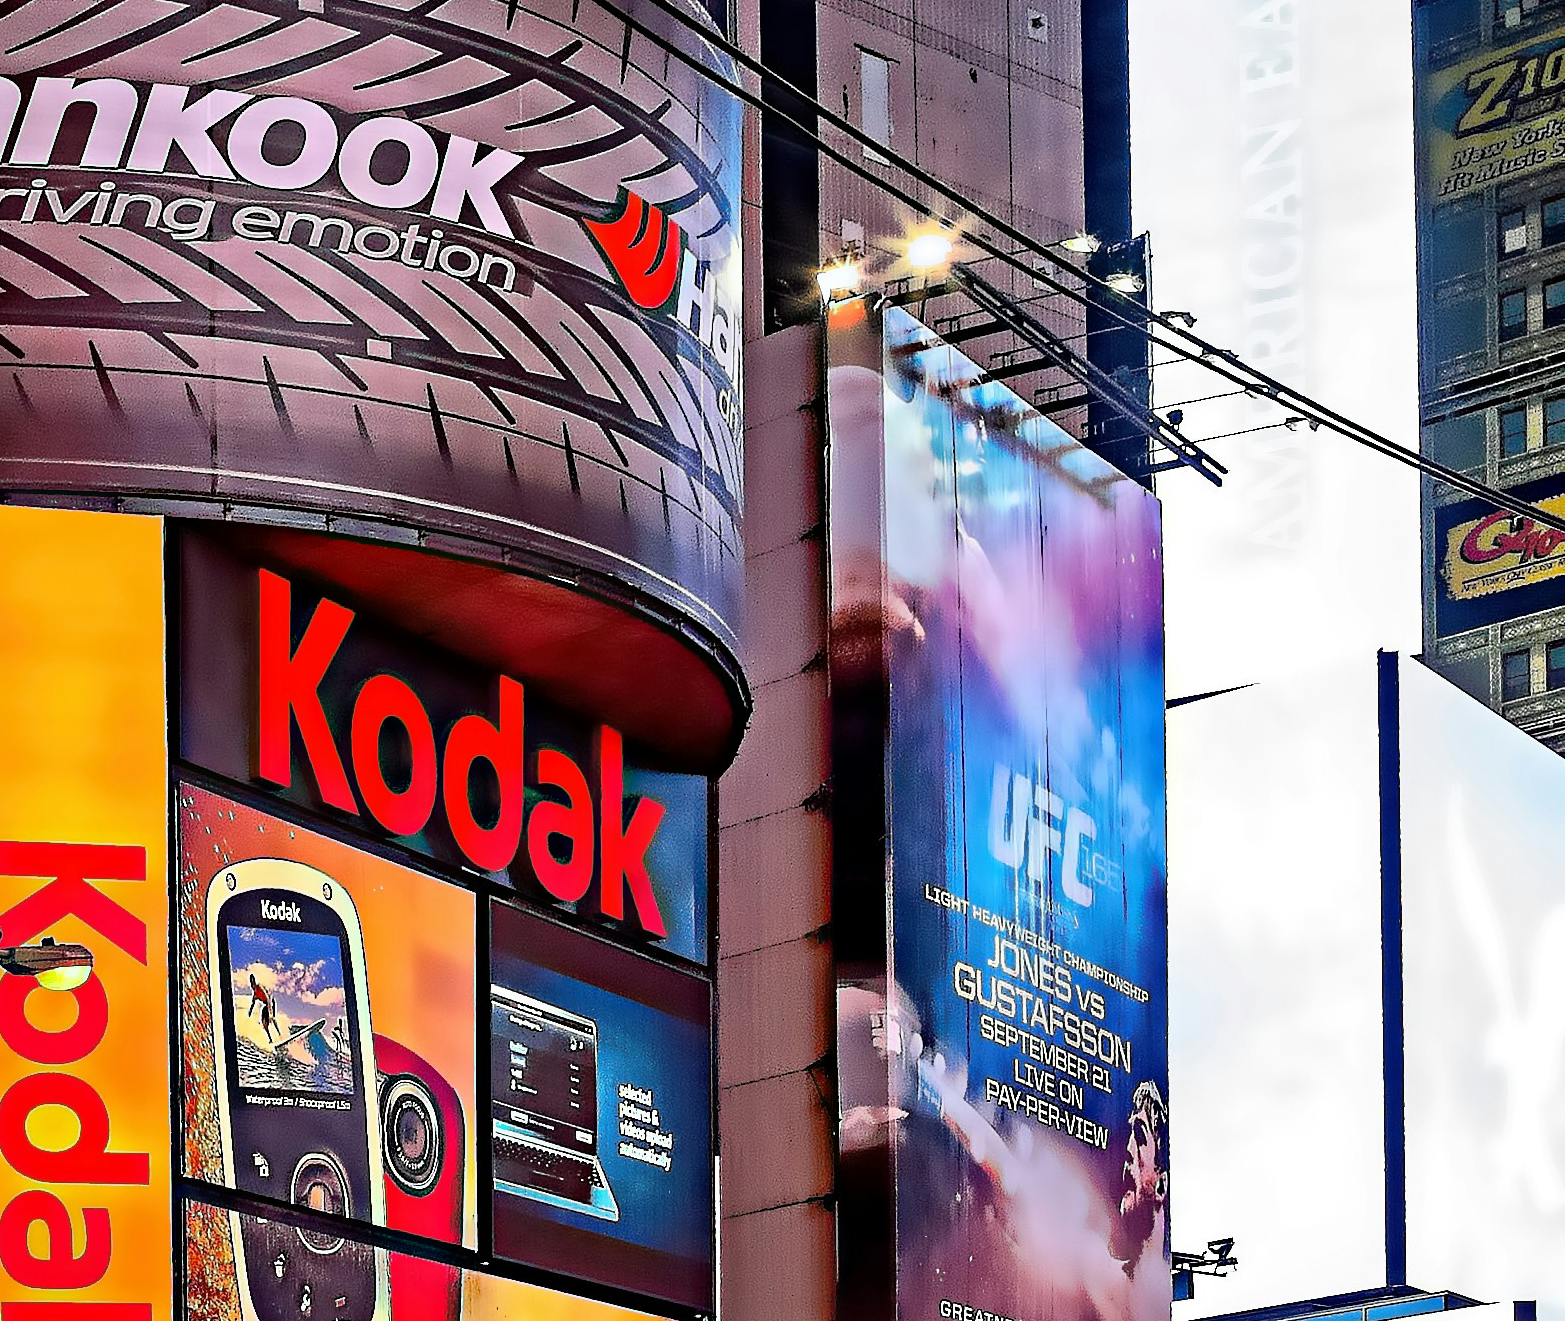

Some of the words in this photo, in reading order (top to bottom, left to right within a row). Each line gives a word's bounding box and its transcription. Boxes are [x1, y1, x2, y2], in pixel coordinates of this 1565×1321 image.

[1475, 148, 1547, 183] Music
[231, 203, 518, 293] emotion
[259, 568, 667, 941] Kodak
[987, 764, 1098, 908] UFC
[260, 898, 302, 922] Kodak
[924, 882, 969, 918] LIGHT
[971, 901, 1061, 960] HEAVYWEIGHT
[1062, 946, 1151, 1004] CHAMPIONSHIP
[952, 961, 1132, 1074] GUSTAFSSON
[987, 934, 1073, 1003] JONES
[1075, 986, 1105, 1020] VS
[980, 1015, 1090, 1085] SEPTEMBER
[1091, 1067, 1113, 1095] 21
[1013, 1058, 1055, 1097] LIVE
[1058, 1081, 1084, 1110] ON
[985, 1077, 1110, 1151] PAY-PER-VIEW
